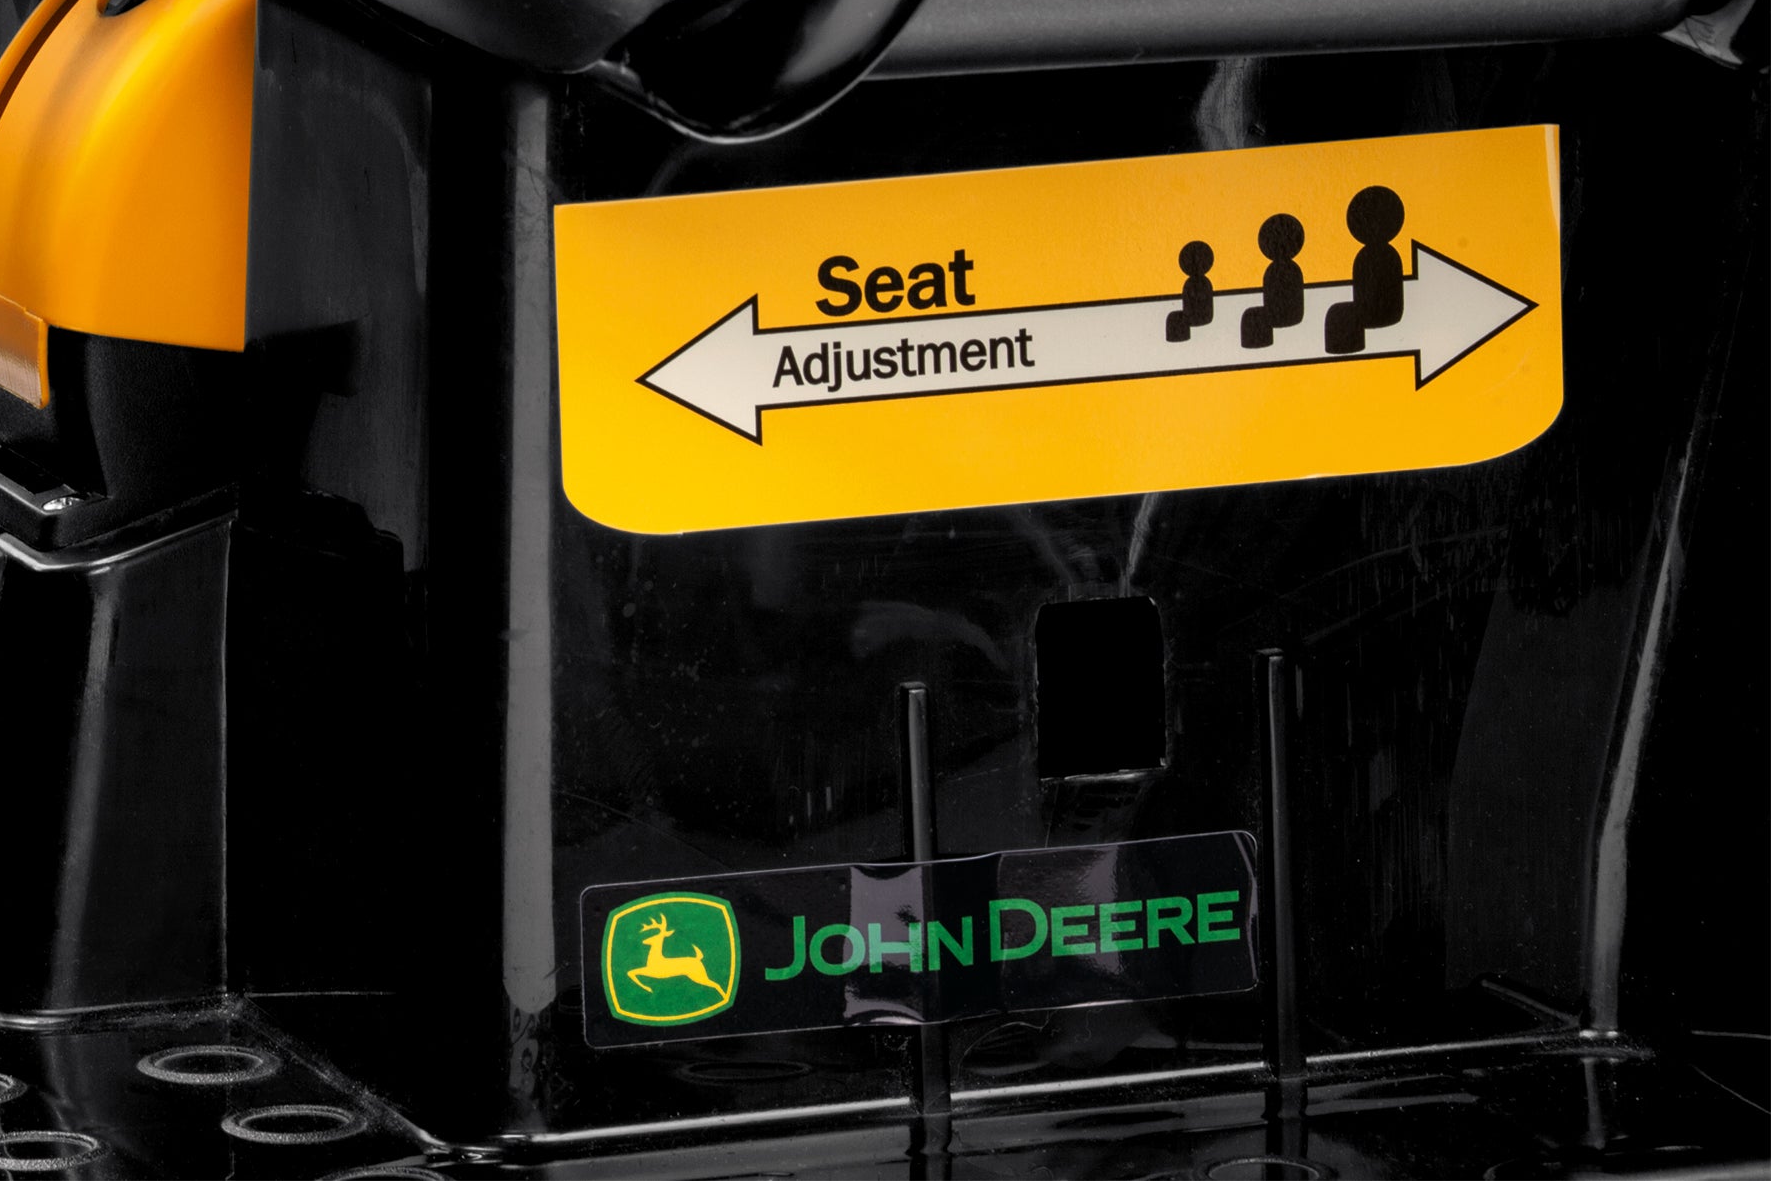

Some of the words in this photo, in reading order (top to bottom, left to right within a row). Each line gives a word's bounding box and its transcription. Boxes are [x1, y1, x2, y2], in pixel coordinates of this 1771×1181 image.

[815, 249, 976, 318] Seat
[772, 328, 1036, 393] Adjustment
[764, 914, 974, 982] JOHN
[988, 889, 1241, 963] DEERE
